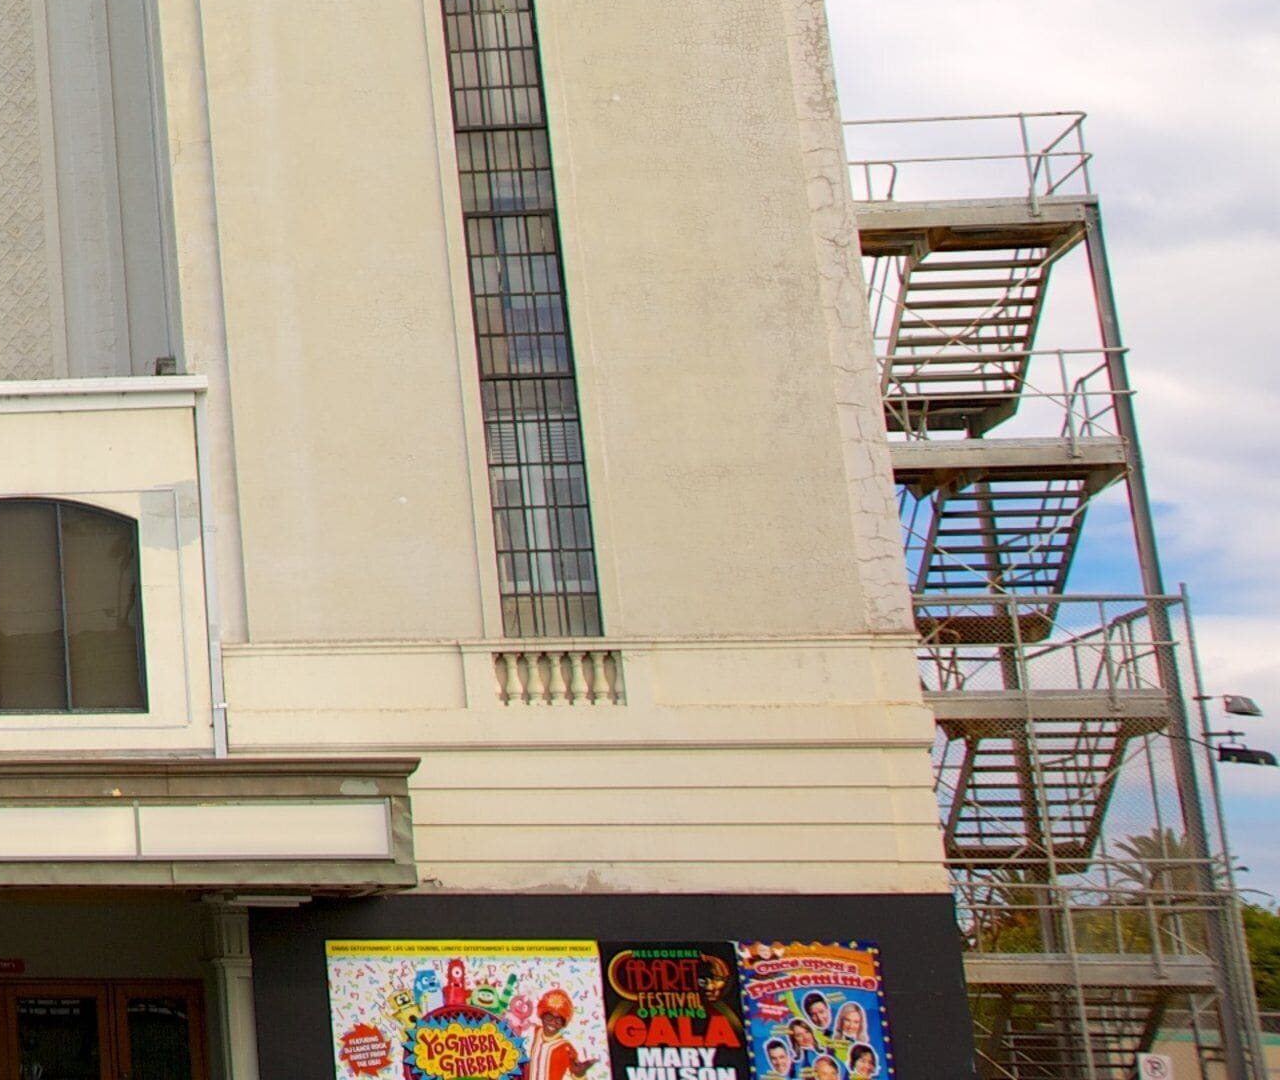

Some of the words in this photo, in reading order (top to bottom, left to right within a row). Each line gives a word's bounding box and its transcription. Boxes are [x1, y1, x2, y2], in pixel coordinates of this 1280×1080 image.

[632, 950, 701, 958] MELBOURNE
[608, 950, 700, 1000] CABARET
[755, 958, 800, 974] Once
[802, 957, 845, 972] upon
[746, 972, 878, 998] Pantomime
[638, 992, 703, 1009] FESTIVAL
[637, 1007, 707, 1019] OPENING
[614, 1014, 741, 1048] GALA
[445, 1033, 500, 1056] GABBA
[440, 1047, 507, 1077] GABBA!
[637, 1047, 717, 1068] MARY
